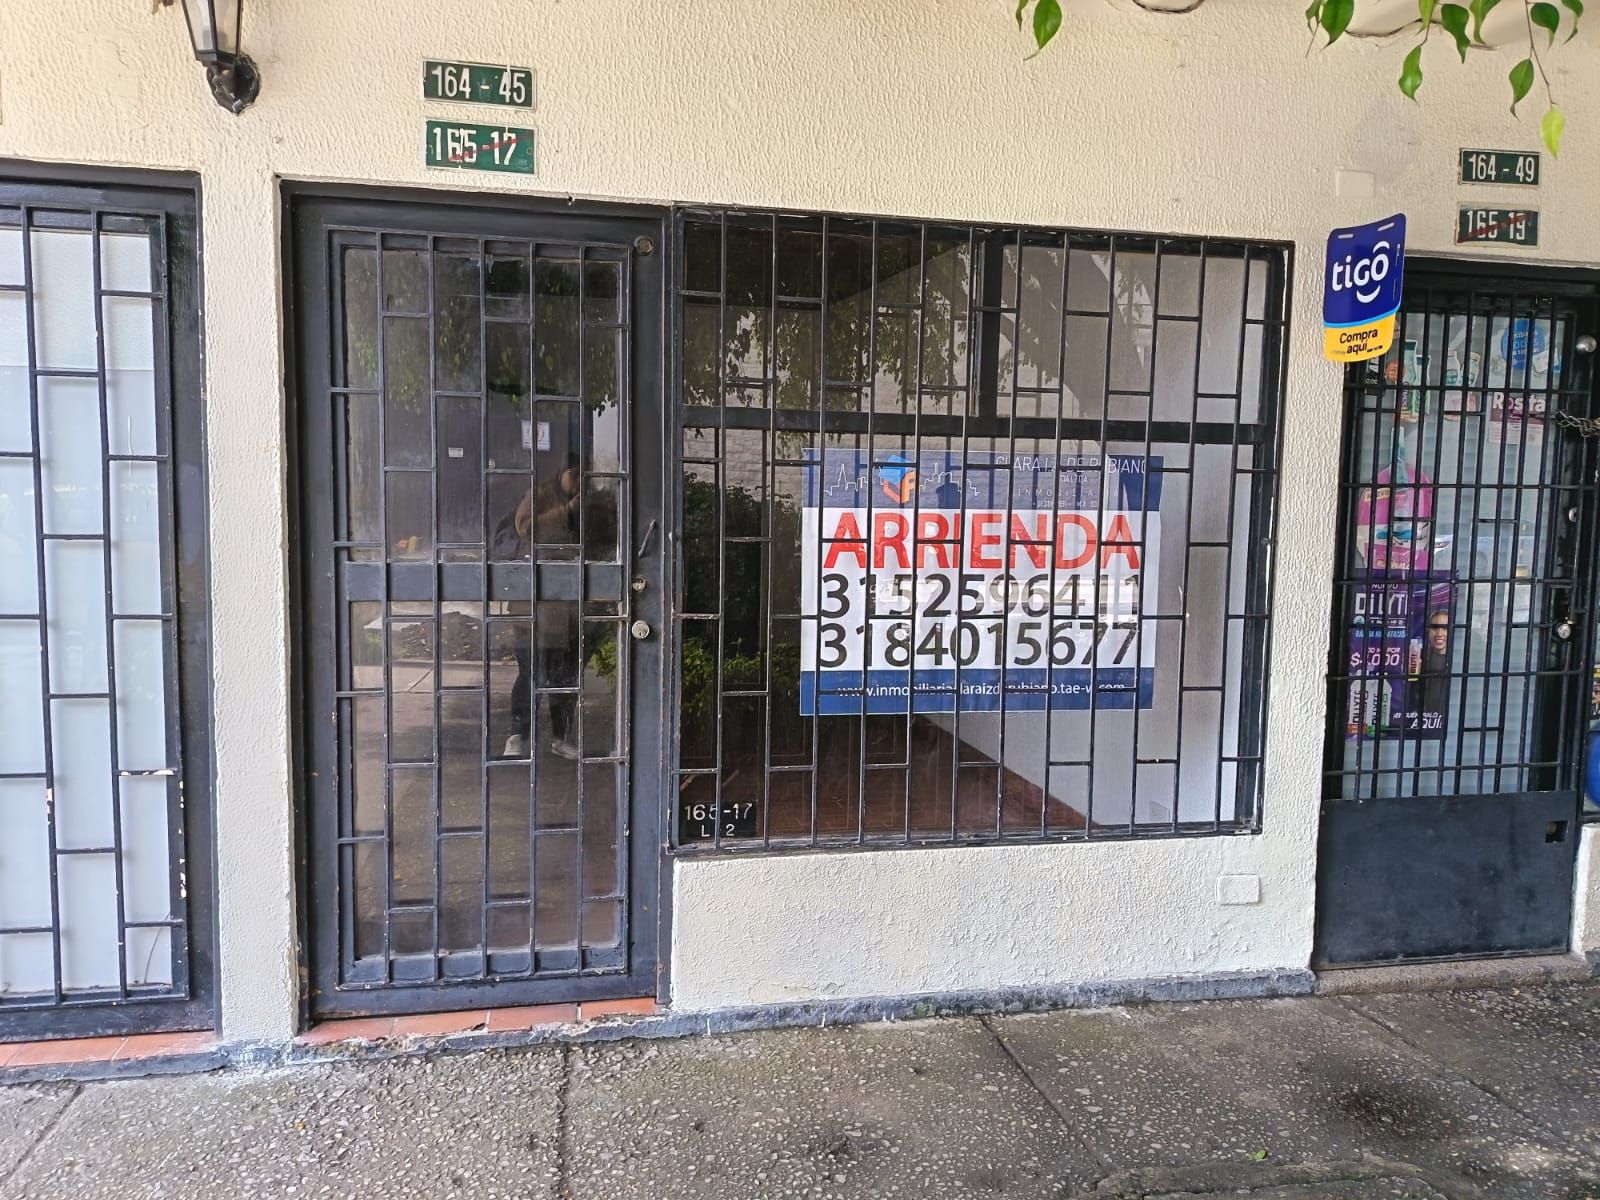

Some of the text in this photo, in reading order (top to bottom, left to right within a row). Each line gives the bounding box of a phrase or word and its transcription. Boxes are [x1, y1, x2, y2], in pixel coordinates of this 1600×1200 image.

[432, 65, 472, 99] 164
[498, 70, 526, 104] 45
[1468, 153, 1497, 181] 164
[1515, 156, 1535, 183] 49
[1339, 328, 1379, 344] Compra
[823, 511, 1142, 570] ARRIENDA
[821, 572, 1140, 619] 3152596411
[819, 621, 1138, 668] 3184015677
[684, 802, 753, 821] 165-17
[701, 823, 736, 838] L 2
